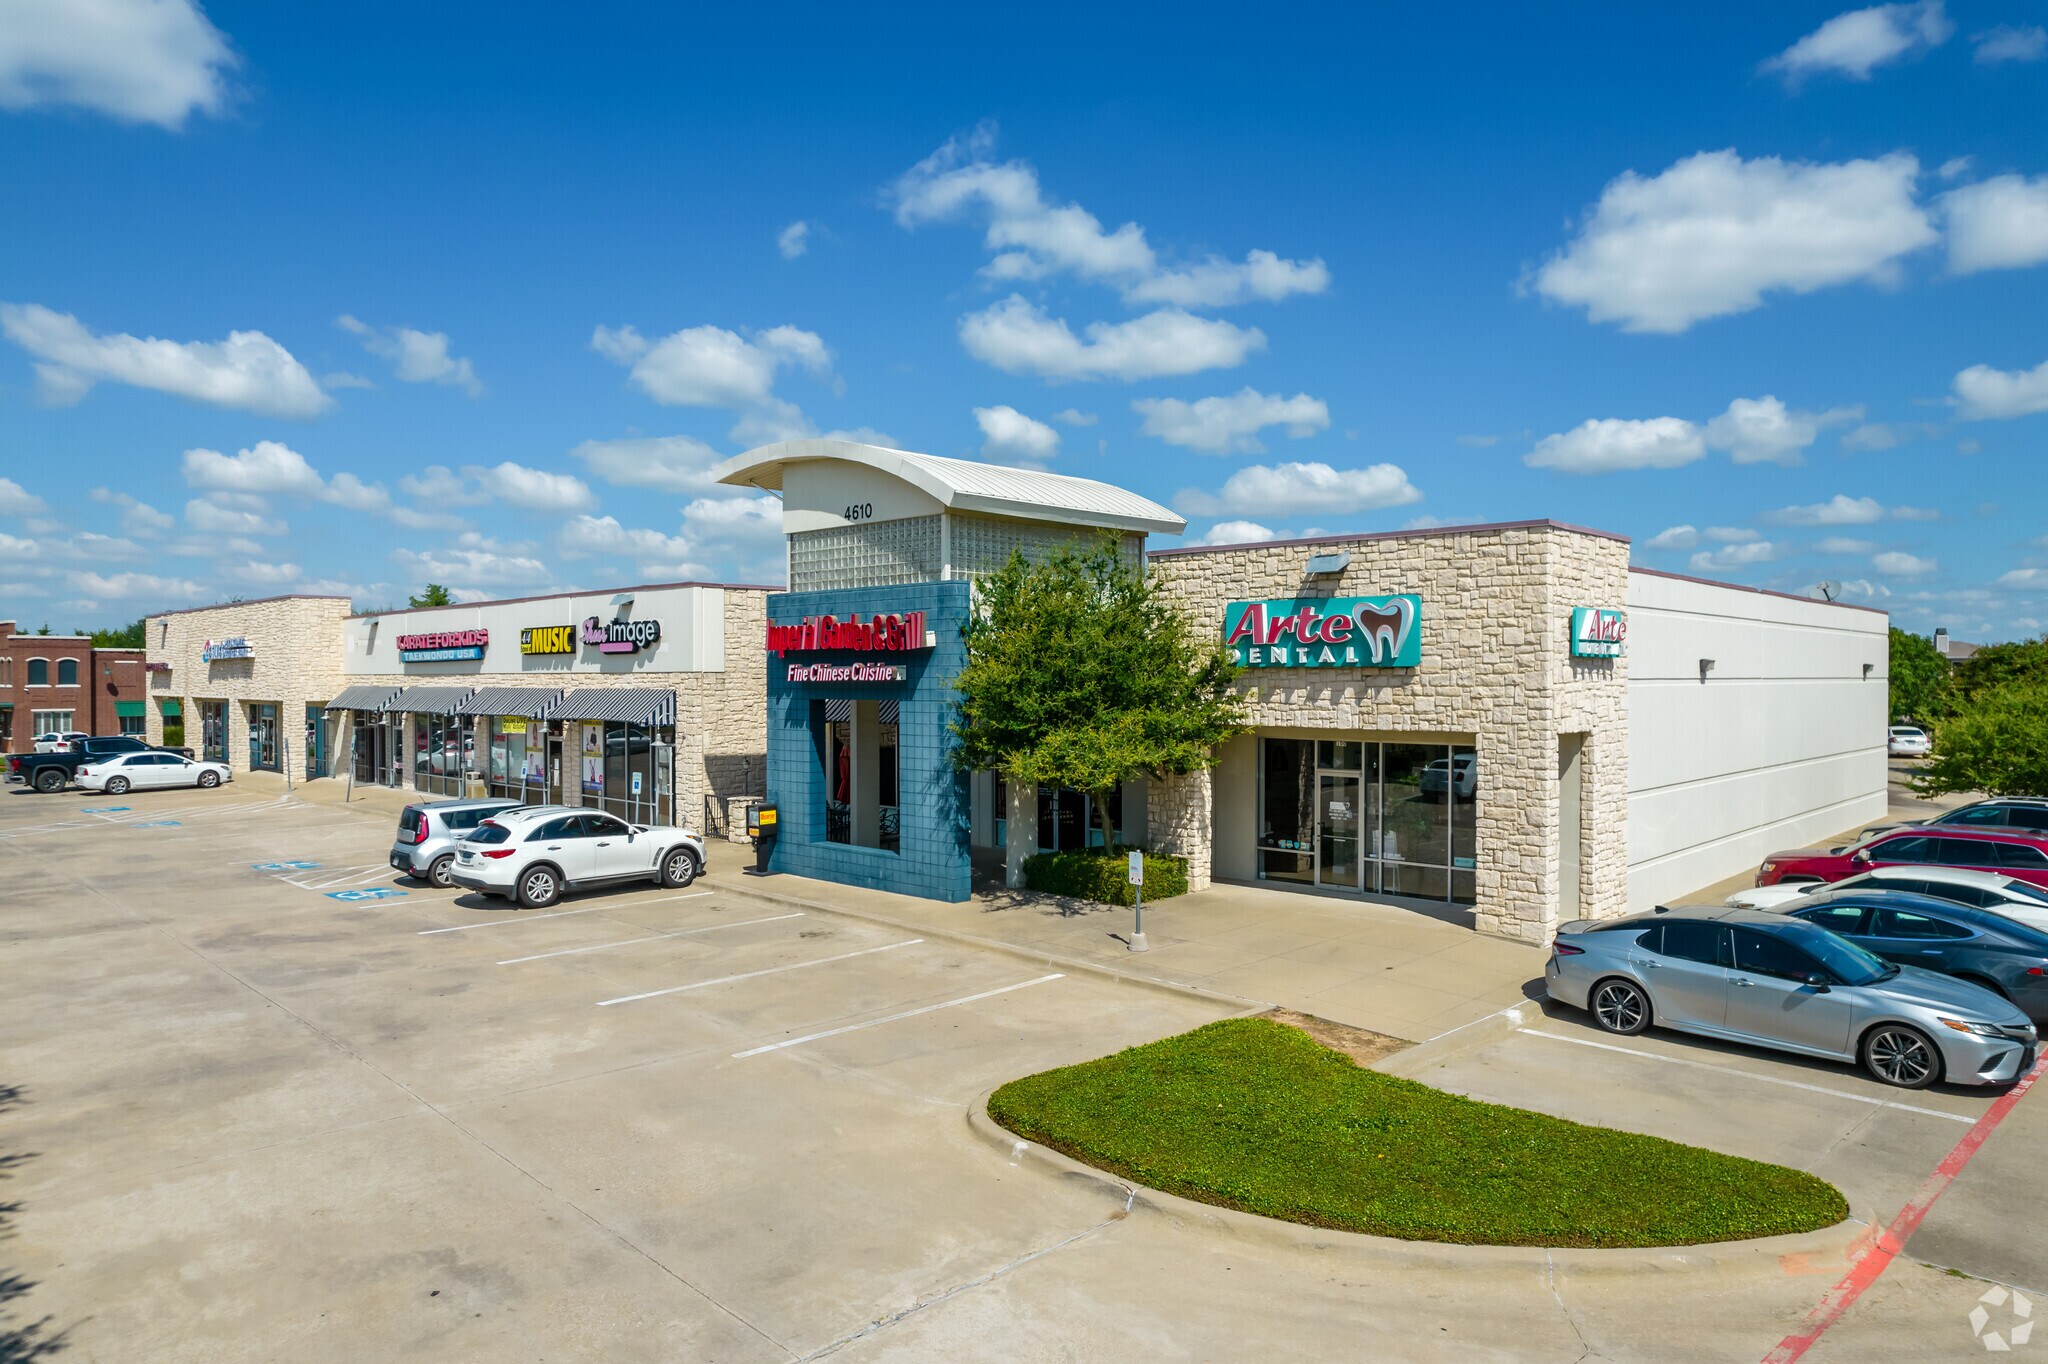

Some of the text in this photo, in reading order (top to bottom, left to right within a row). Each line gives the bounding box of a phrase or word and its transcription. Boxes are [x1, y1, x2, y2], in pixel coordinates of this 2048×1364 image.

[844, 502, 873, 521] 4610
[765, 611, 924, 659] Imperial Garden & Grill
[1226, 603, 1354, 646] Arte
[1587, 609, 1627, 641] Arte
[396, 630, 486, 650] KARATE FOR KIDS
[531, 626, 572, 654] MUSIC
[404, 648, 475, 661] TAEKWONDO USA
[787, 662, 893, 682] Fine Chinese Cuisine
